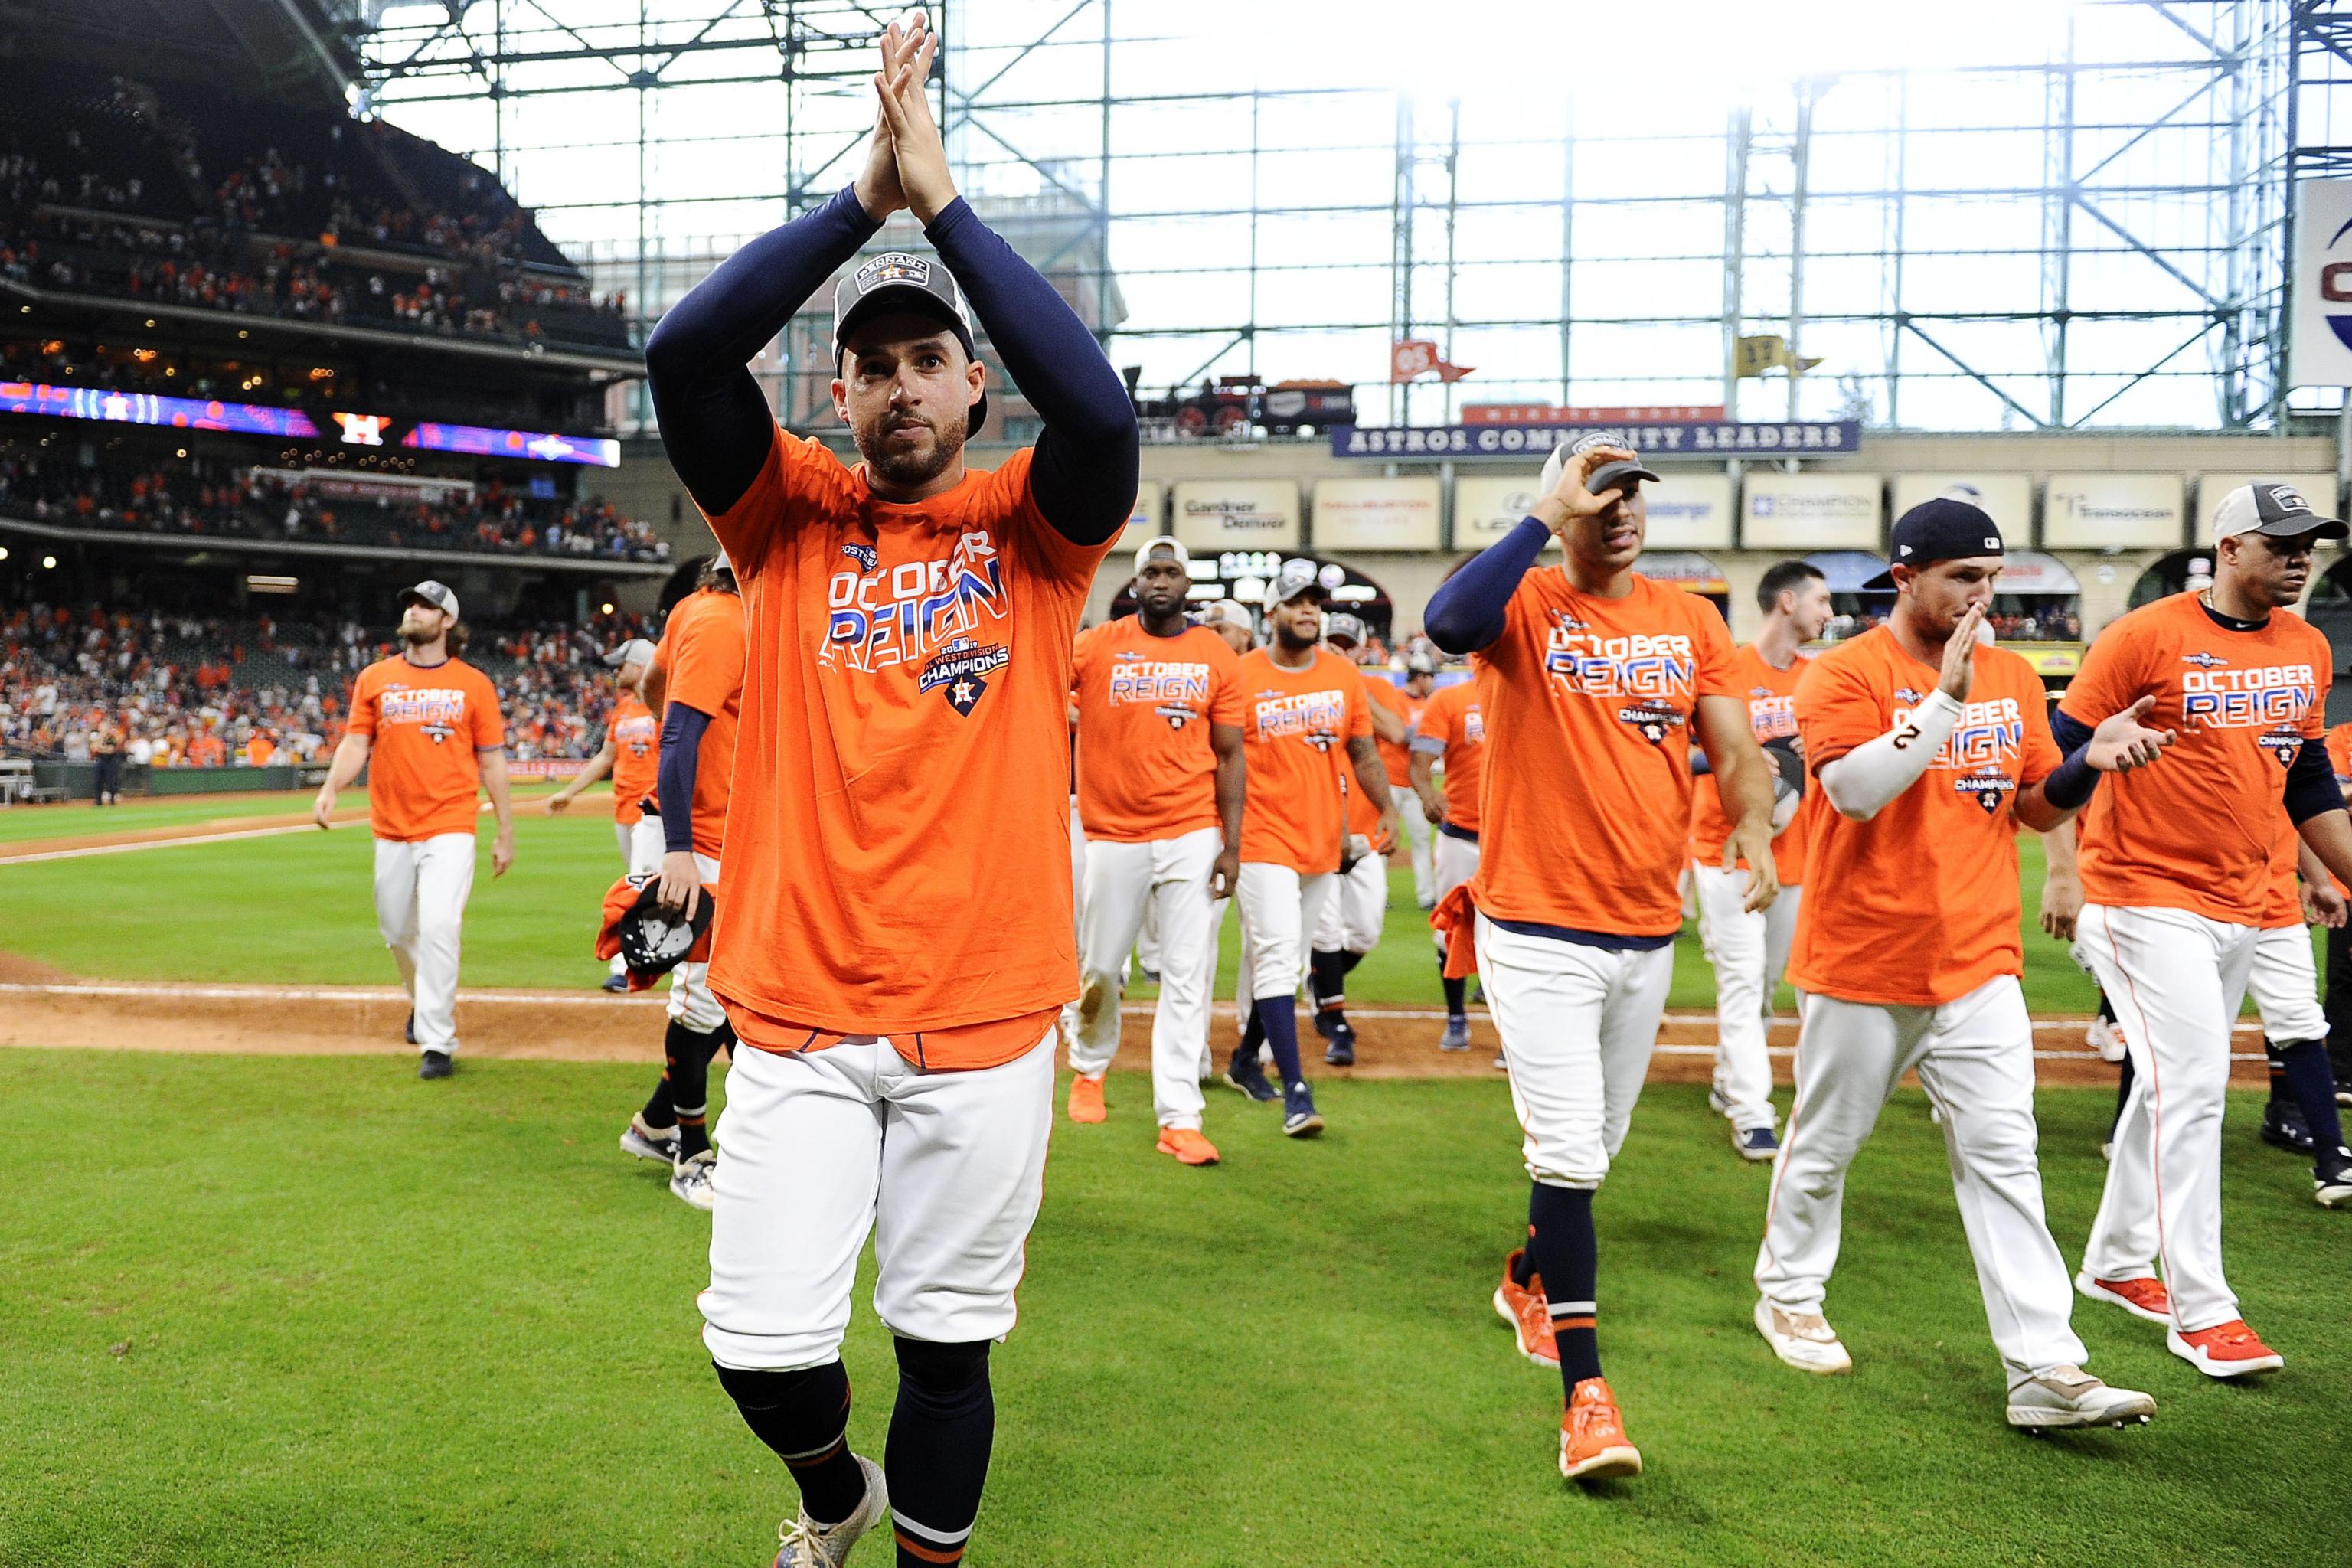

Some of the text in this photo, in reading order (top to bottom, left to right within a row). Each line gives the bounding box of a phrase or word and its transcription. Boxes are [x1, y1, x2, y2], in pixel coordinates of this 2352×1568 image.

[859, 255, 926, 281] PENNANT
[1348, 429, 1467, 452] ASTROS
[1478, 426, 1684, 451] COMMITY
[1694, 425, 1842, 449] LEADERS
[828, 531, 996, 611] OCOBER
[818, 557, 1008, 674] REIGN
[919, 647, 1009, 688] CHAMPIONS
[935, 652, 962, 665] WEST
[963, 645, 999, 658] DIVISION
[1112, 662, 1210, 678] OCTOBER
[1544, 648, 1695, 697] REIGN
[2183, 664, 2315, 692] OCTOBER
[381, 688, 466, 704] OCTOBER
[1109, 675, 1209, 702] REIGN
[381, 701, 465, 724] REIGN
[1256, 689, 1344, 716] OCTOBER
[2183, 684, 2317, 729] REIGN
[1258, 703, 1345, 740] REIGN
